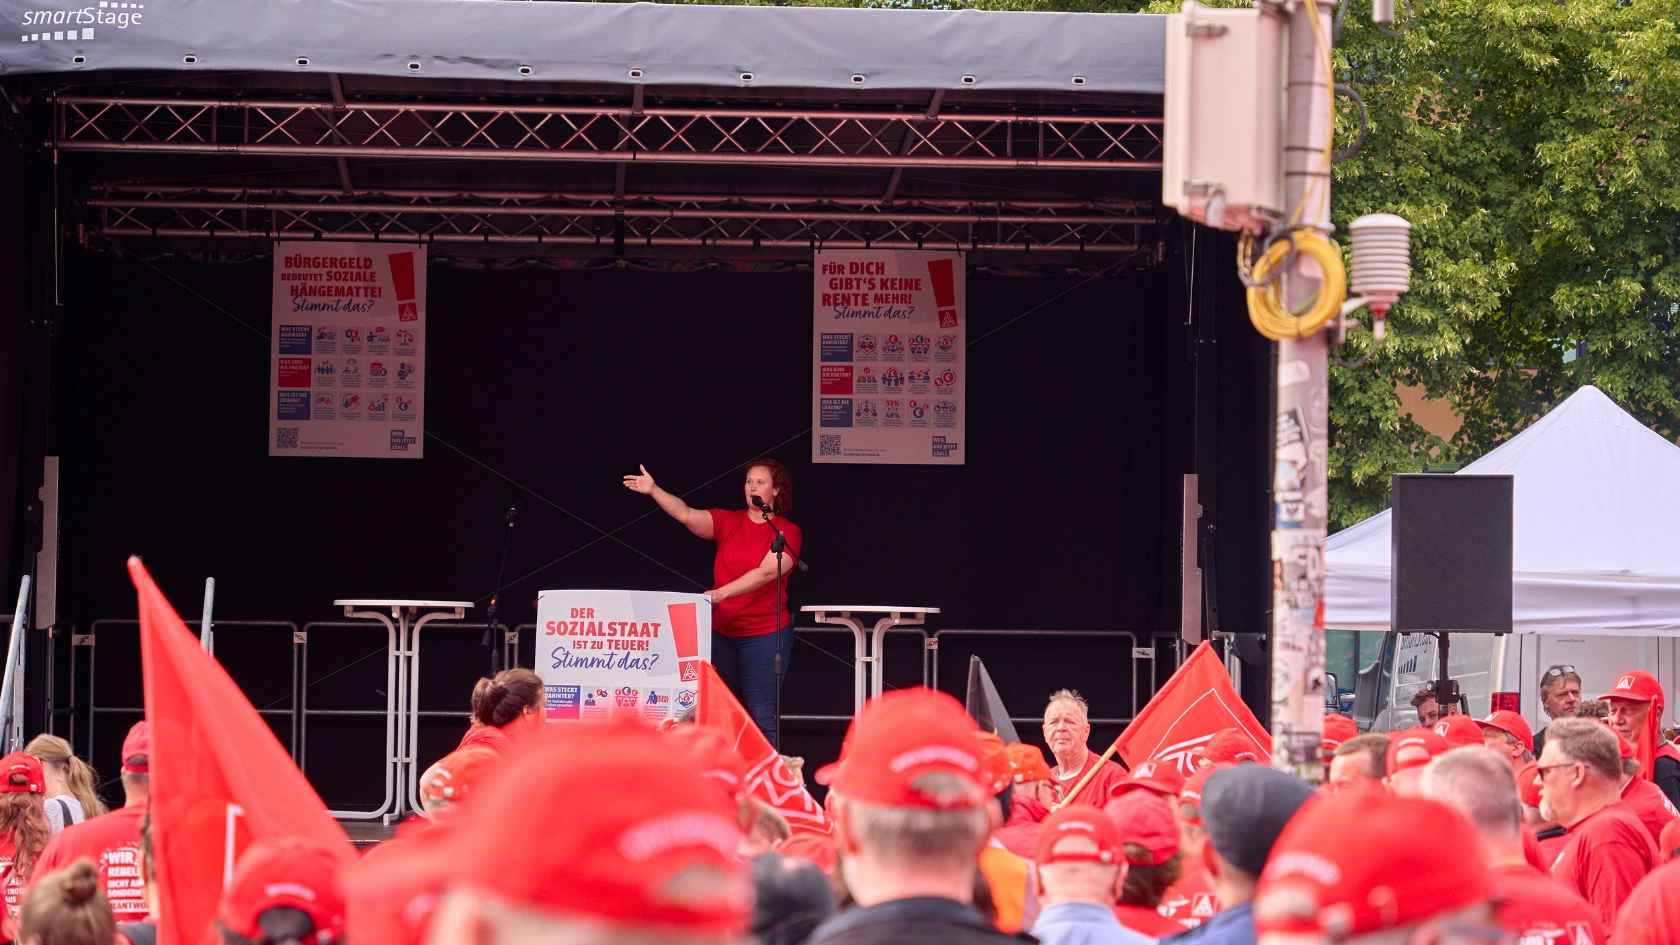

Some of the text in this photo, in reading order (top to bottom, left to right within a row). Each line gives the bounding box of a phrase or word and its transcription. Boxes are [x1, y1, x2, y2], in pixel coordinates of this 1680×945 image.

[22, 7, 142, 29] smartStage
[284, 253, 373, 269] BÜRGERGELD
[822, 261, 885, 275] FÜR DICH
[281, 271, 376, 282] BEDEUTET SOZIALE
[290, 283, 382, 298] HÄNGEMATTE!
[879, 278, 922, 291] KEINE
[292, 295, 375, 312] Stimmt das?
[822, 293, 912, 306] RENTE MEHR!
[833, 302, 915, 319] Stimmt das?
[570, 607, 595, 619] DER
[545, 620, 662, 638] SOZIALSTAAT
[572, 639, 649, 651] IST ZU TEUER!
[551, 646, 660, 670] Stimmt das?
[107, 851, 134, 865] WIR
[107, 879, 130, 888] NICHT
[107, 888, 142, 898] SONDERN
